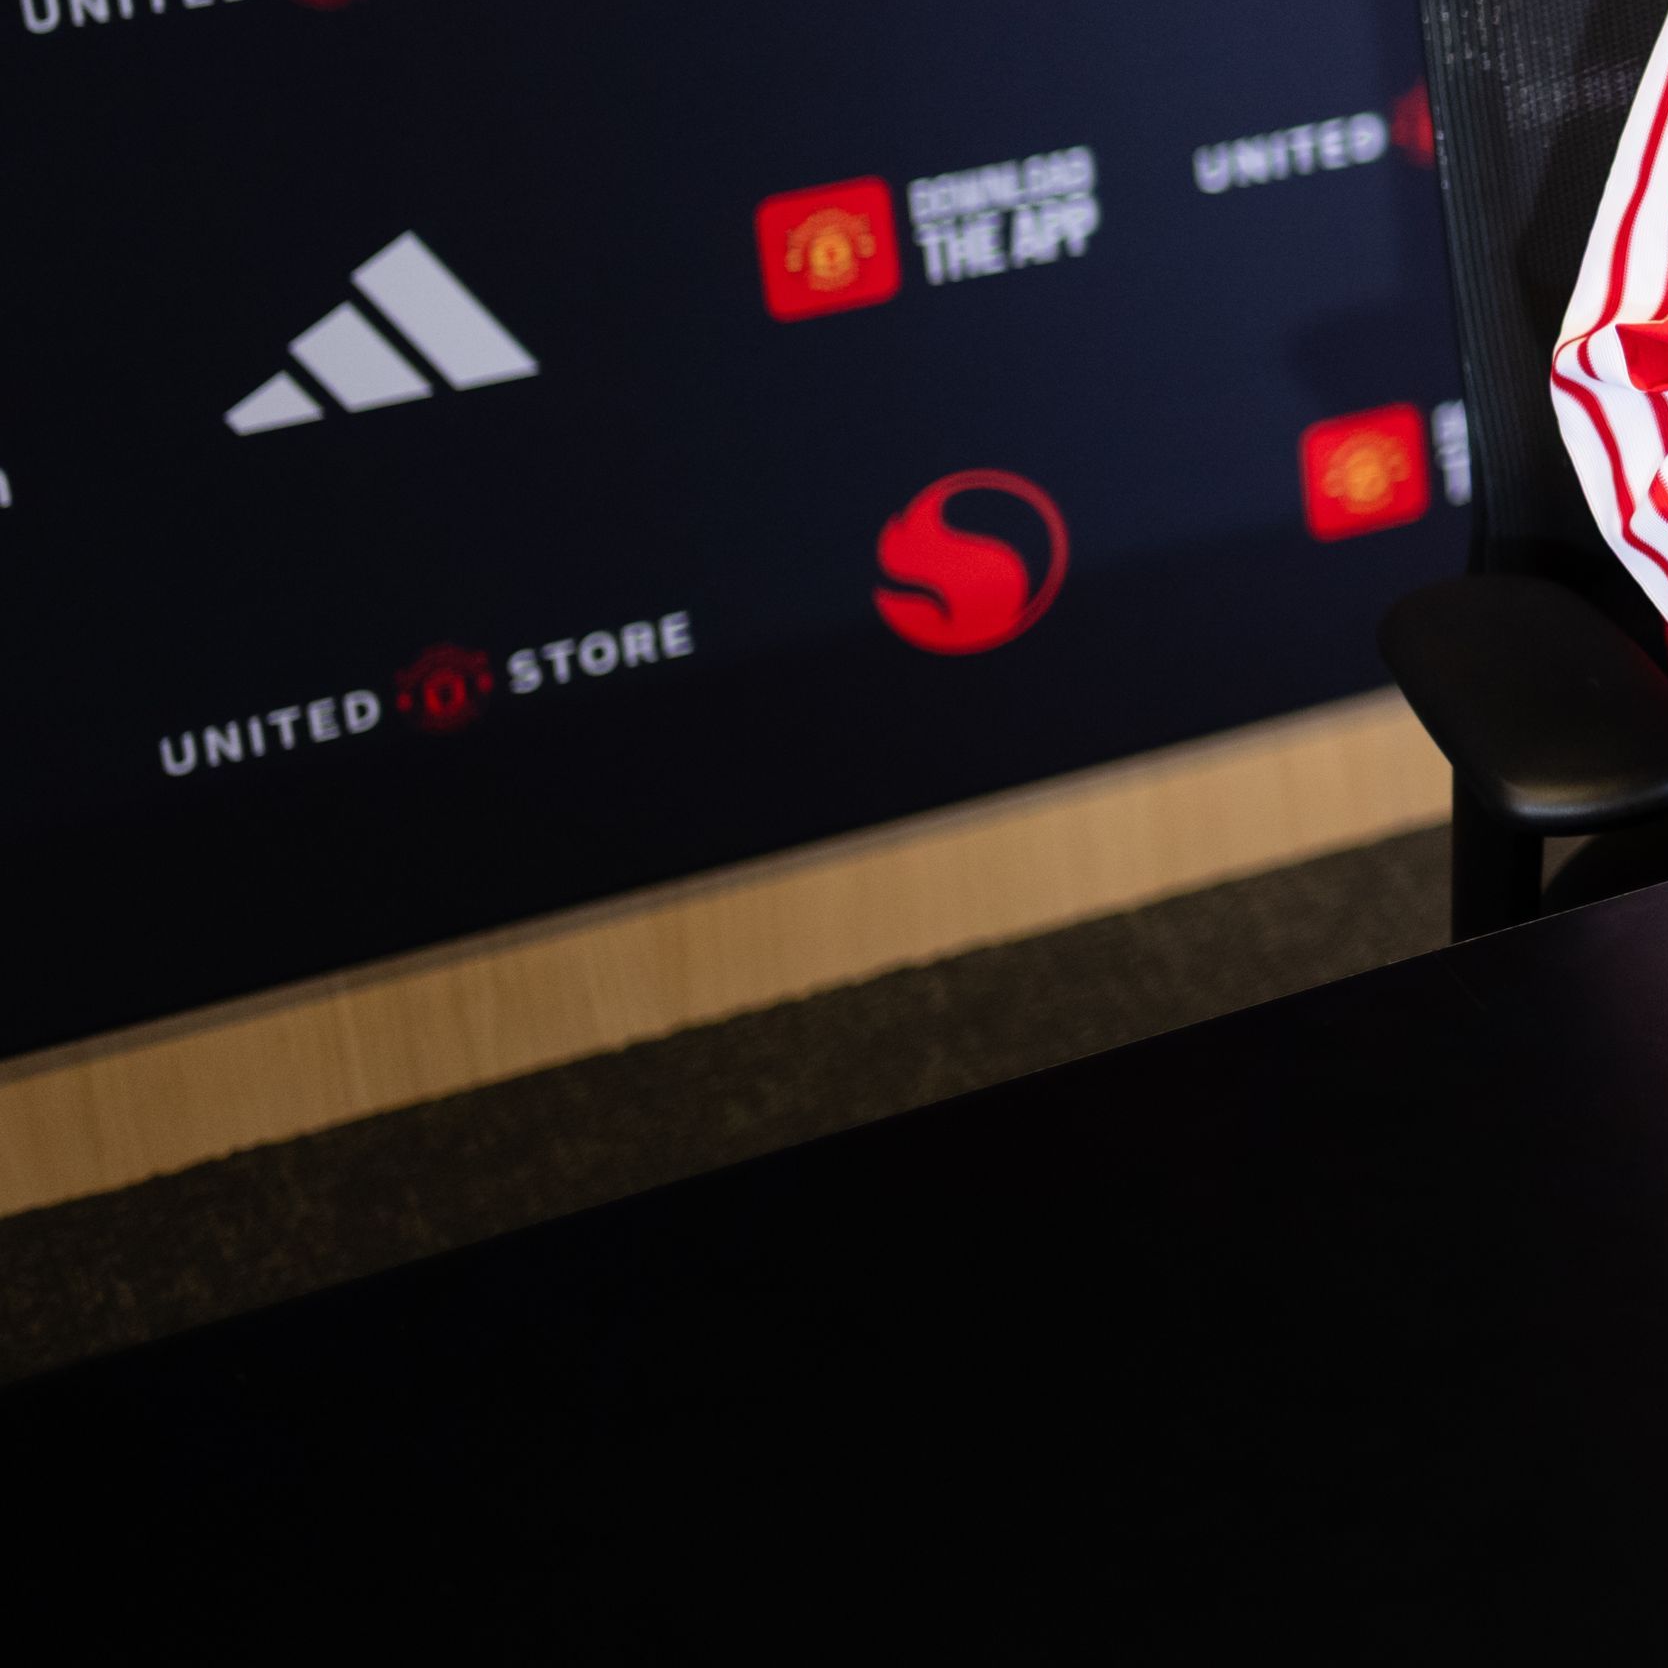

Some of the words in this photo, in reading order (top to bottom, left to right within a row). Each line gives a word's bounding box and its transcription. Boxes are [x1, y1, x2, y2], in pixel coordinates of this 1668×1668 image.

[907, 145, 1095, 225] DOWNLOAD
[1194, 113, 1387, 193] UNITED
[913, 212, 1007, 285] THE
[1010, 196, 1100, 269] APP
[160, 690, 380, 776] UNITED
[508, 612, 692, 693] STORE
